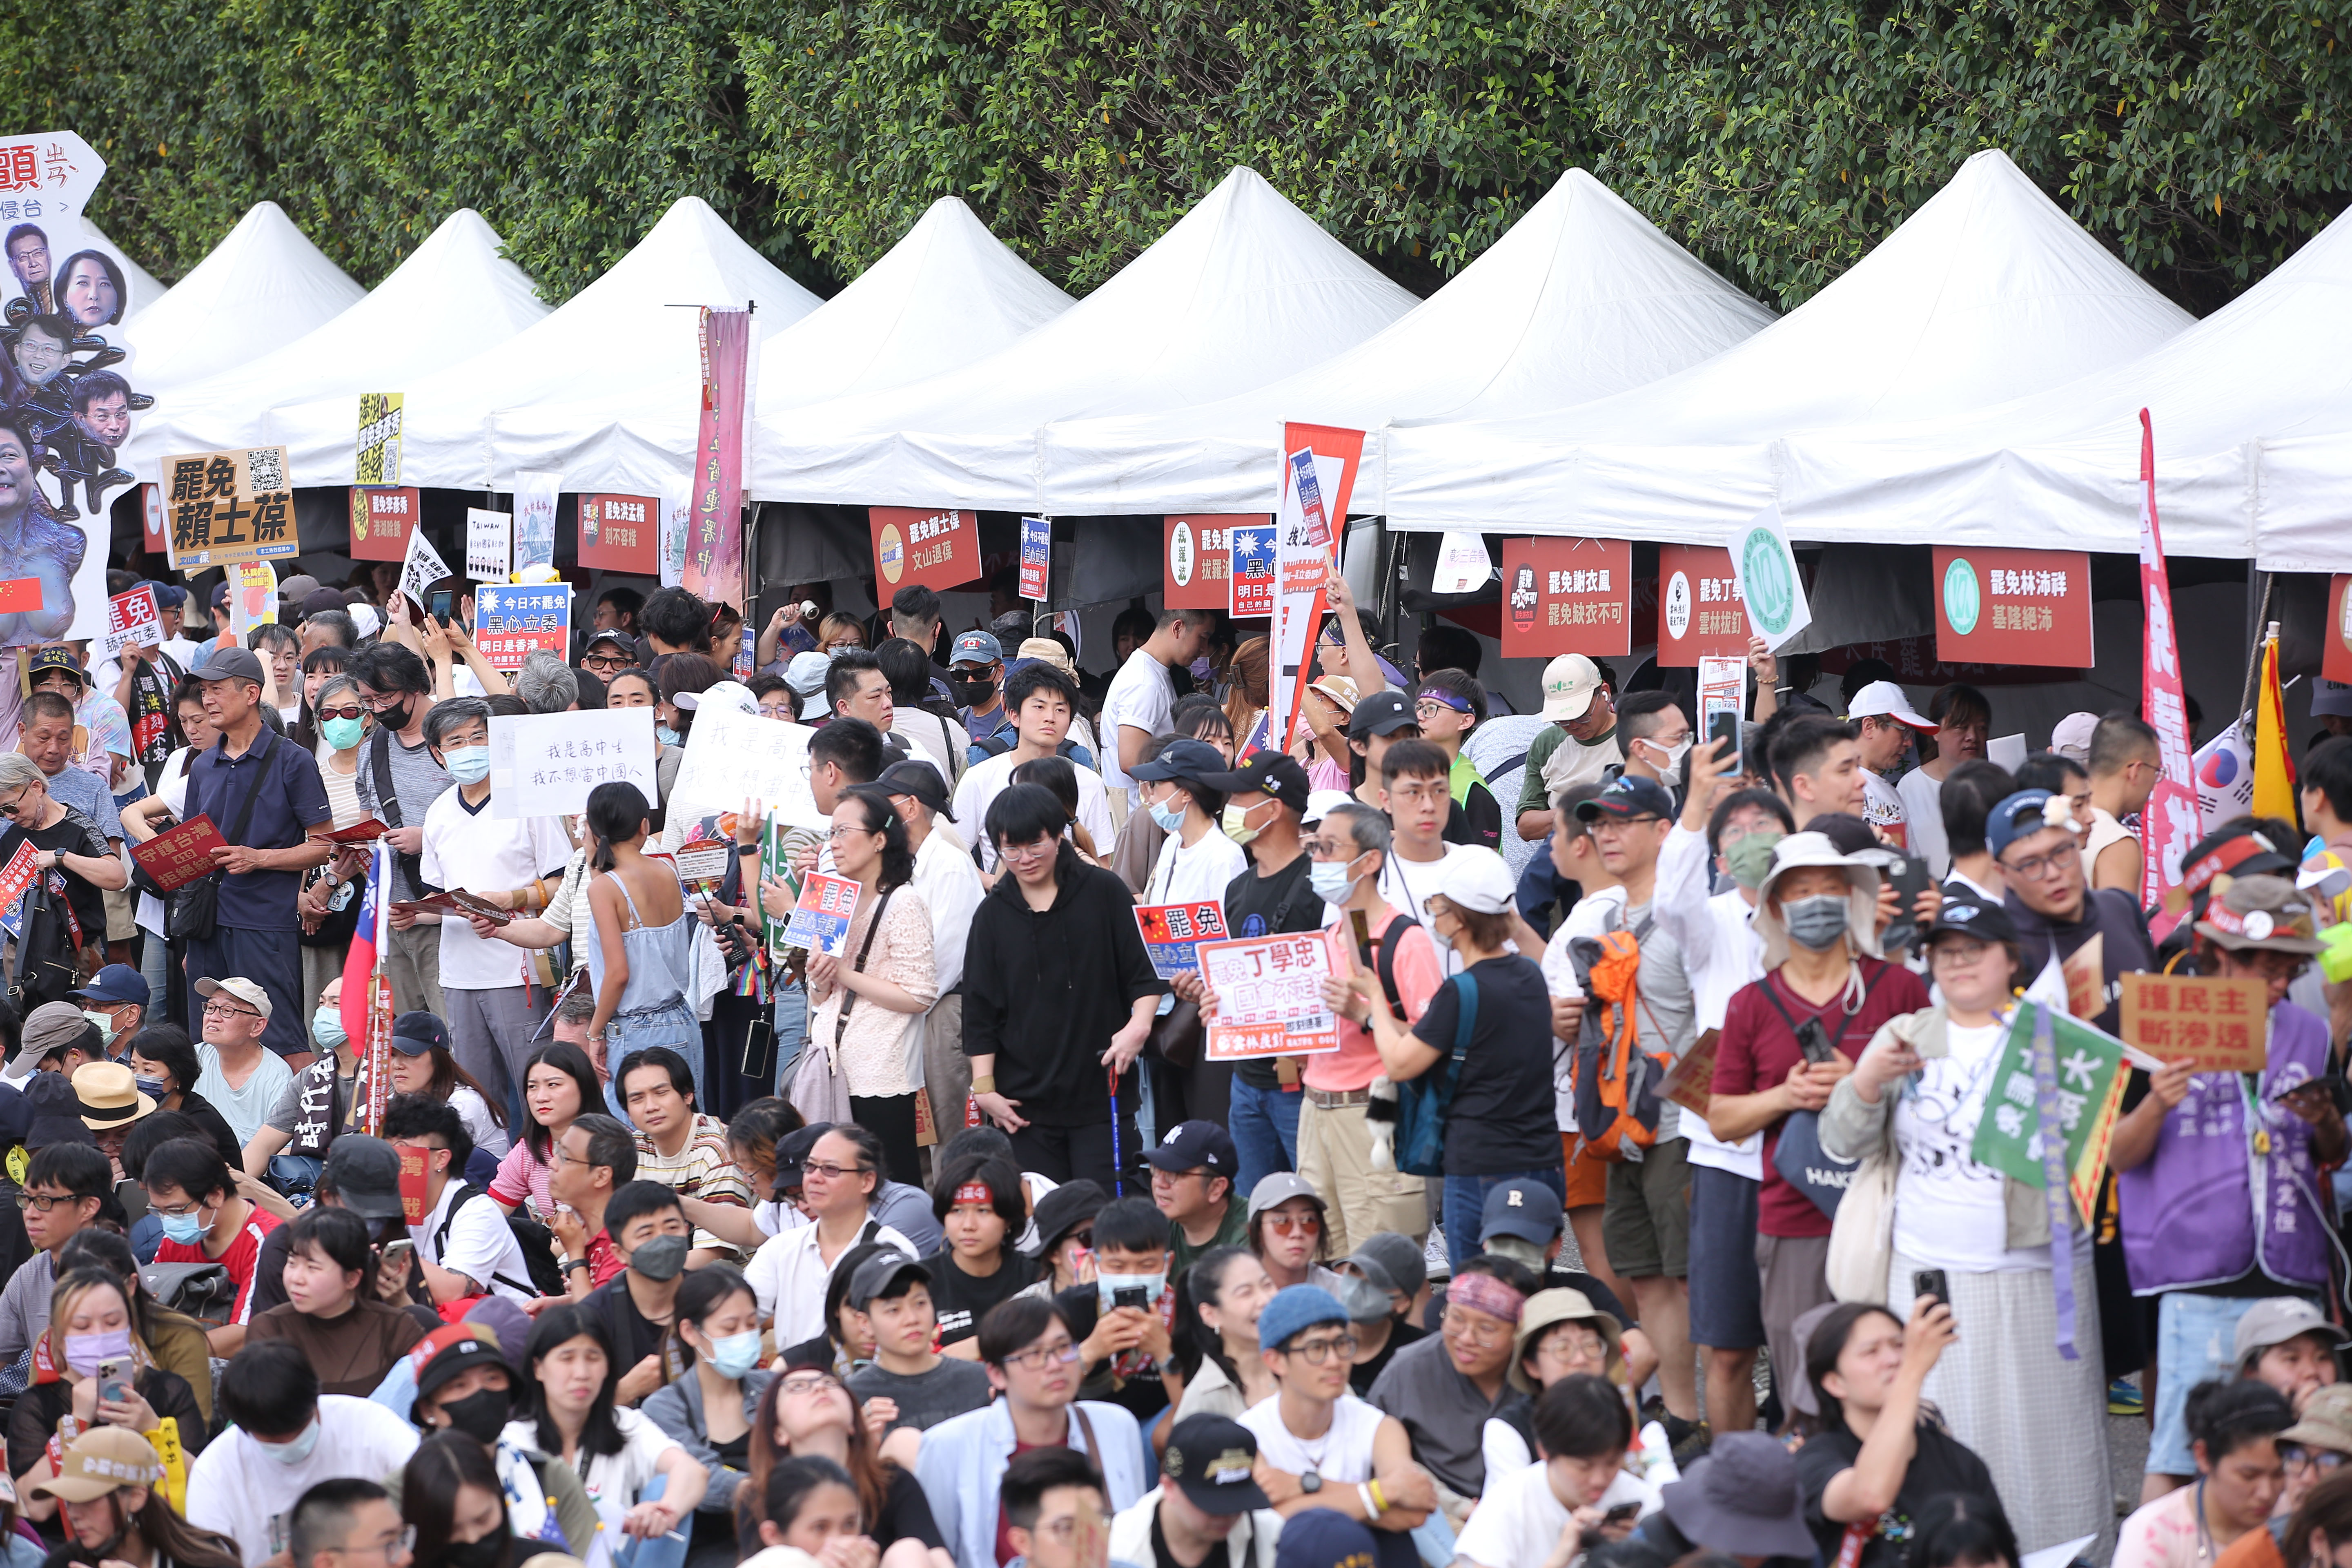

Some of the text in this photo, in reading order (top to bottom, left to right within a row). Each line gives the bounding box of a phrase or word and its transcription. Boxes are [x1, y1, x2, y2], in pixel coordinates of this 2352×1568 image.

[171, 458, 235, 501] 罷免
[372, 495, 408, 514] 罷免李彥秀
[605, 501, 646, 523] 罷免洪孟楷
[174, 493, 290, 550] 賴士葆
[909, 510, 960, 544] 罷免賴士葆
[605, 526, 637, 547] 刻不容楷
[1030, 530, 1048, 545] 今日不罷免
[912, 540, 953, 572] 文山退葆
[1024, 546, 1046, 567] 黑心立委
[1449, 548, 1486, 563] 彰三告急
[1022, 568, 1040, 582] 明日是香港
[1519, 568, 1533, 588] 罷免
[1548, 569, 1611, 594] 罷免謝衣鳳
[1990, 568, 2067, 597] 罷免林沛祥
[503, 595, 566, 611] 今日不罷免
[1548, 601, 1623, 626] 罷免缺衣不可
[487, 613, 558, 635] 黑心立委
[1699, 611, 1742, 635] 雲林拔釘
[1992, 604, 2053, 632] 基隆絕沛
[480, 638, 539, 653] 明日是香港
[43, 655, 68, 664] 龍城宮
[545, 739, 624, 759] 我是高中生
[532, 763, 643, 785] 我不想當中國人
[138, 822, 212, 862] 守護台灣
[175, 850, 194, 863] 419
[820, 881, 855, 915] 罷免
[791, 910, 837, 938] 黑心立委
[1165, 906, 1223, 939] 罷免
[1245, 939, 1316, 977] 丁學忠
[2137, 983, 2249, 1016] 護民主
[2137, 1019, 2249, 1050] 斷滲透
[1507, 1189, 1523, 1207] R
